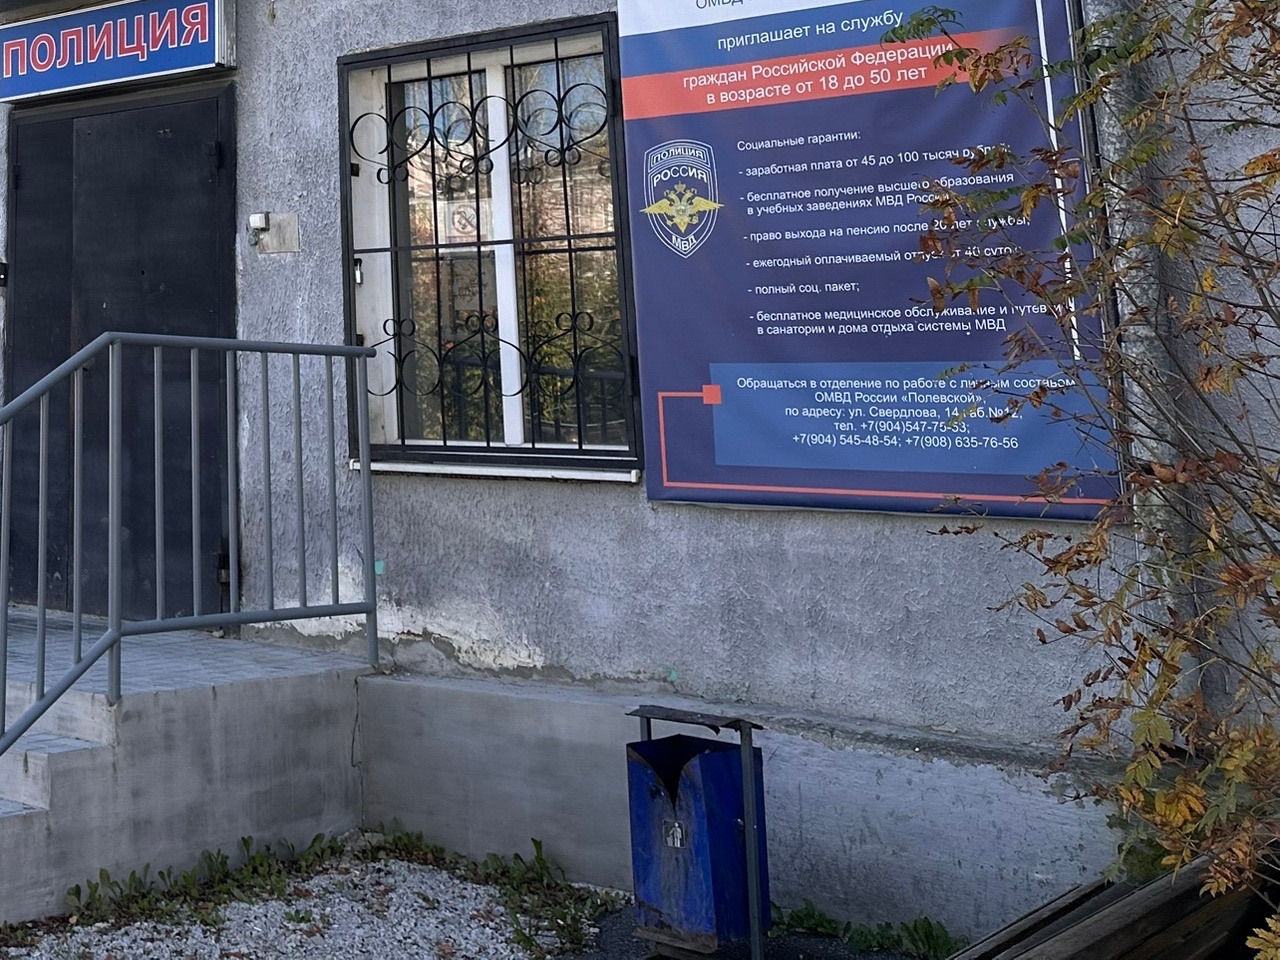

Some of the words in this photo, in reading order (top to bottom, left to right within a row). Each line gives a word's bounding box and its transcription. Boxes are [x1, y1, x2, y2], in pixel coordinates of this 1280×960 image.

[718, 25, 810, 51] приглашает
[815, 21, 836, 35] на
[841, 10, 903, 32] службу
[3, 2, 209, 79] ПОЛИЦИЯ
[683, 70, 747, 90] граждан
[752, 54, 845, 80] Российской
[851, 43, 953, 66] Федерации
[707, 93, 715, 104] в
[720, 83, 791, 103] возрасте
[796, 80, 813, 93] от
[819, 75, 838, 91] 18
[843, 75, 865, 89] до
[870, 69, 891, 86] 50
[896, 67, 928, 81] лет
[737, 136, 805, 151] Социальные
[808, 131, 861, 145] гарантии:
[653, 147, 703, 163] ПОЛИЦИЯ
[746, 163, 808, 178] заработная
[810, 159, 843, 171] плата
[846, 158, 858, 168] от
[861, 155, 876, 166] 45
[879, 154, 894, 166] до
[898, 151, 919, 163] 100
[922, 149, 959, 160] тысяч
[654, 166, 707, 187] РОССИЯ
[747, 187, 811, 202] бесплатное
[814, 184, 875, 198] получение
[747, 207, 754, 215] в
[756, 202, 804, 217] учебных
[806, 197, 873, 212] заведениях
[875, 194, 903, 207] МВД
[750, 230, 782, 243] право
[785, 228, 826, 240] выхода
[829, 227, 843, 237] на
[846, 225, 890, 236] пенсию
[893, 221, 929, 232] после
[672, 235, 697, 251] МВД
[753, 255, 812, 268] ежегодный
[814, 250, 901, 265] оплачиваемый
[950, 249, 961, 258] т
[755, 283, 796, 295] полный
[798, 283, 822, 294] соц.
[824, 282, 860, 292] пакет;
[756, 310, 822, 322] бесплатное
[824, 308, 901, 320] медицинское
[999, 306, 1008, 315] и
[1011, 304, 1062, 317] путеви
[757, 327, 764, 335] в
[766, 325, 825, 336] санатории
[828, 325, 836, 333] и
[838, 324, 868, 334] дома
[871, 323, 914, 335] отдыха
[917, 322, 971, 331] системы
[975, 318, 1007, 331] МВД
[736, 377, 807, 390] Обращаться
[810, 380, 817, 388] в
[820, 380, 882, 390] отделение
[885, 380, 900, 389] по
[903, 377, 946, 390] работе
[949, 380, 957, 389] с
[814, 392, 851, 404] ОМВД
[855, 392, 898, 403] России
[901, 392, 987, 404] «Полевской»,
[785, 407, 799, 416] по
[802, 407, 845, 418] адресу:
[848, 408, 866, 419] ул.
[869, 406, 941, 419] Свердлова,
[834, 422, 857, 431] тел.
[793, 433, 836, 447] +7(904)
[839, 435, 902, 447] 545-48-54;
[905, 436, 952, 450] +7(908)
[955, 437, 1019, 449] 635-76-56
